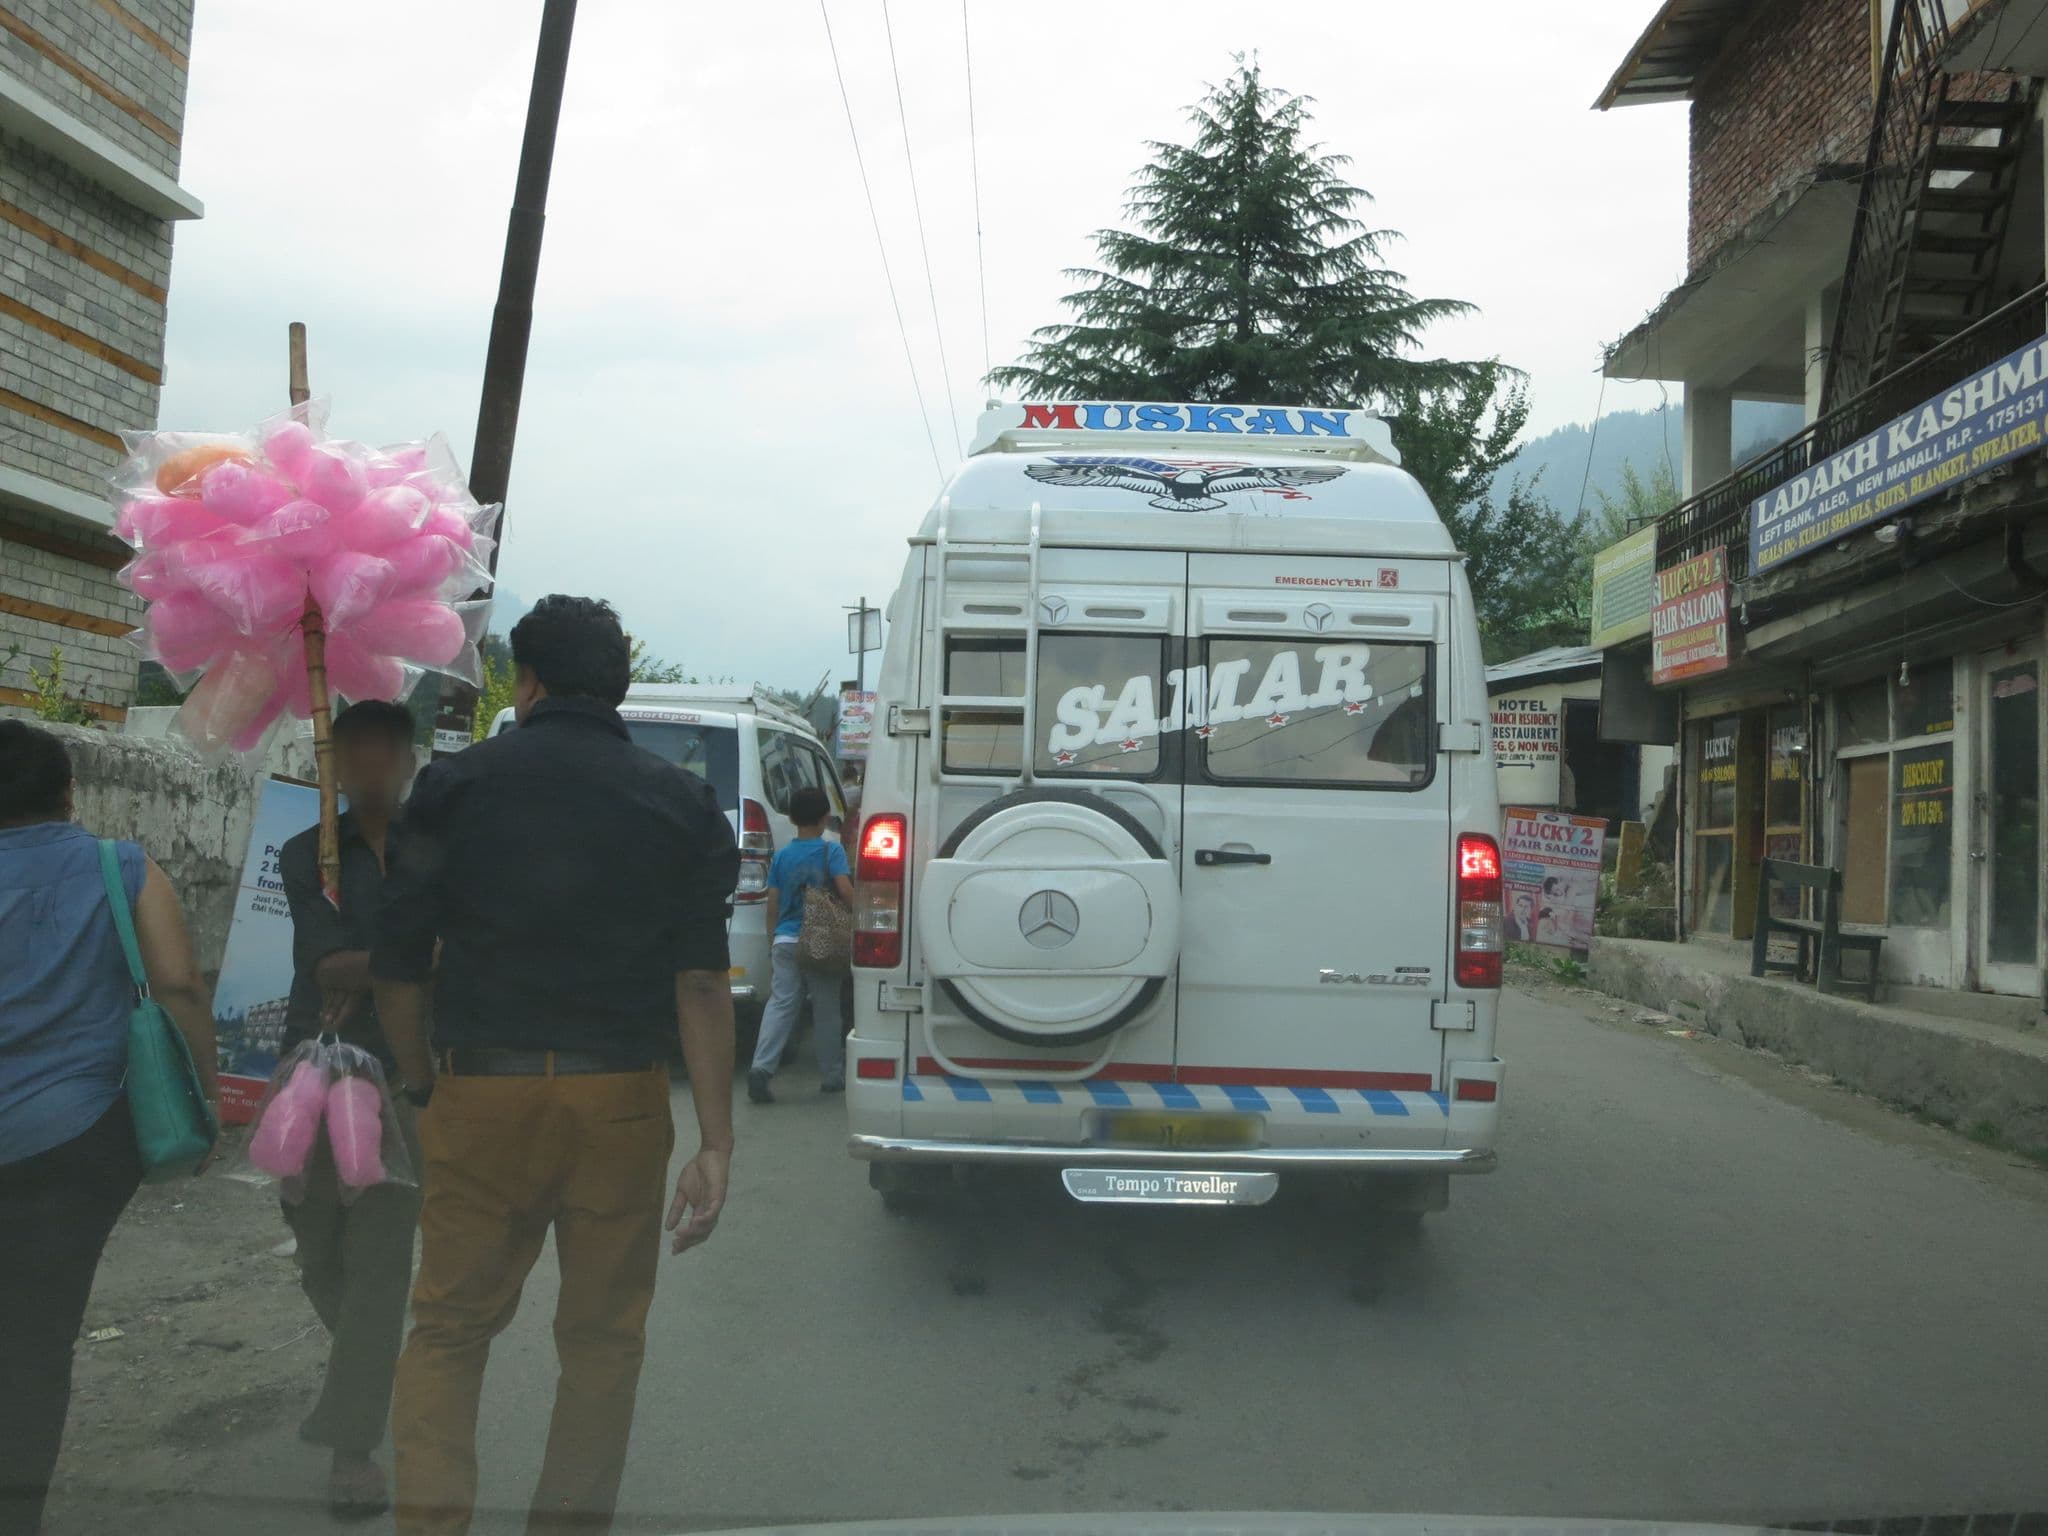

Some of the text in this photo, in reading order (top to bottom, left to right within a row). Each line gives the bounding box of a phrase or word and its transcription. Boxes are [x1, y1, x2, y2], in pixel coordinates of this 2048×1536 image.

[1017, 404, 1351, 438] MUSKAN
[1759, 524, 1782, 546] LEFT
[1784, 510, 1815, 534] BANK,
[1817, 491, 1849, 519] ALEO,
[1856, 471, 1883, 497] NEW
[1886, 445, 1942, 481] MANALI,
[1947, 428, 1973, 453] H.P.
[1986, 389, 2045, 433] 175131
[1757, 435, 1879, 528] LADAKH
[1758, 542, 1783, 567] DEALS
[1798, 526, 1830, 548] KULLU
[1910, 452, 1969, 497] BLANKET,
[1971, 422, 2041, 468] SWEATER,
[1275, 575, 1372, 588] EMERGENCY EXIT
[1653, 606, 1678, 638] HAIR
[1680, 588, 1725, 630] SALOON
[1048, 642, 1373, 753] SAMAR
[1498, 700, 1547, 711] HOTEL
[1519, 713, 1558, 726] RESIDENCY
[1493, 727, 1558, 739] RESTAURENT
[1518, 741, 1539, 752] NON
[1541, 741, 1559, 752] VEG
[1903, 760, 1944, 788] DISCOUNT
[1514, 820, 1594, 846] LUCKY 2
[1507, 838, 1600, 858] HAIR SALOON
[260, 861, 269, 871] 2
[253, 895, 288, 907] Just Pay
[268, 907, 283, 917] free
[1320, 969, 1432, 986] TRAVELLER
[1105, 1176, 1238, 1196] Tempo Traveller
